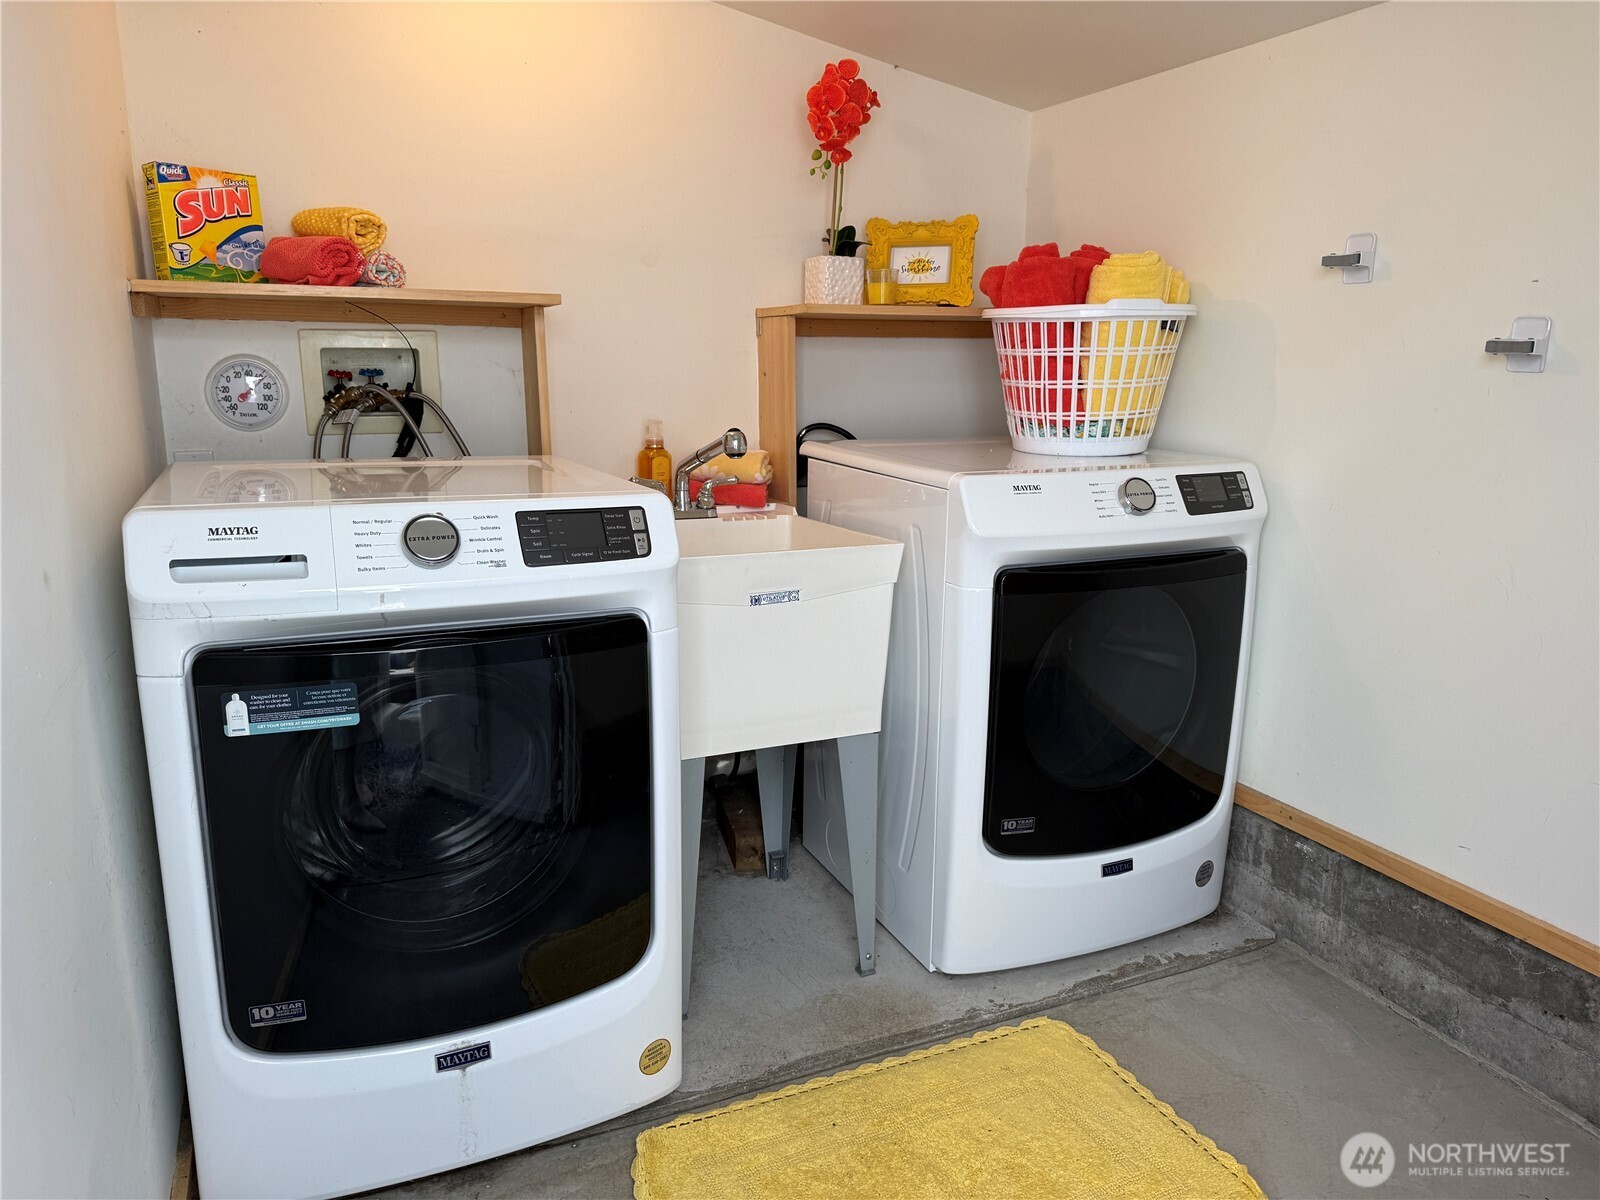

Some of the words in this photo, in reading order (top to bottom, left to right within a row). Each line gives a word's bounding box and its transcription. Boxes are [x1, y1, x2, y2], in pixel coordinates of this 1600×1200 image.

[160, 164, 183, 176] Quick
[223, 178, 249, 187] Classic
[173, 186, 252, 239] SUN
[233, 371, 242, 379] 20
[243, 369, 253, 377] 40
[225, 375, 231, 383] 0
[218, 385, 230, 394] -20
[262, 382, 272, 390] 80
[262, 394, 274, 402] 100
[226, 402, 239, 411] -60
[256, 402, 269, 411] 120
[1012, 484, 1042, 492] MAYTAG
[207, 526, 259, 536] MAYTAG
[250, 693, 272, 701] Designed
[1003, 820, 1017, 830] 10
[1103, 861, 1132, 876] MAYTAG
[251, 1006, 275, 1020] 10
[275, 1002, 302, 1011] YEAR
[440, 1047, 489, 1068] MAYTAG
